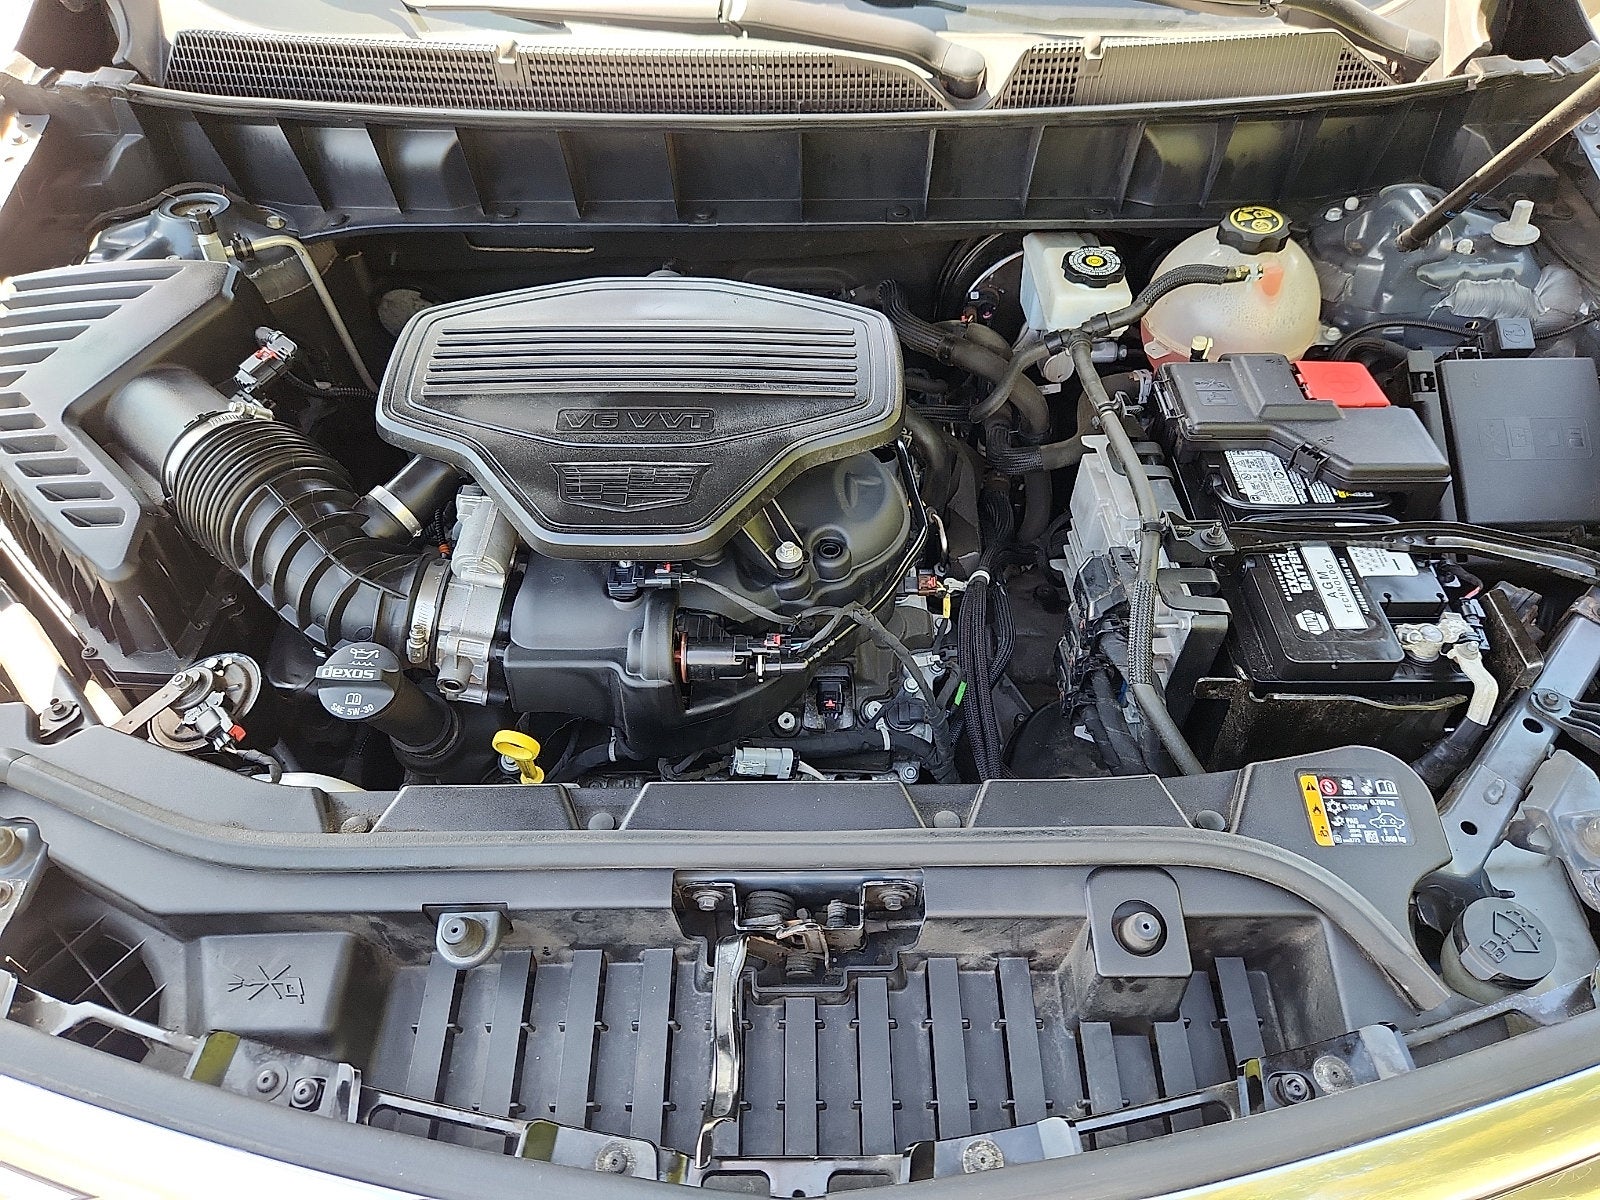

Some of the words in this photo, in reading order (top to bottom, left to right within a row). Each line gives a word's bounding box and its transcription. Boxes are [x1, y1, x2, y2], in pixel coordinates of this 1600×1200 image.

[564, 412, 619, 428] V6
[627, 412, 710, 428] VVT
[1268, 553, 1293, 602] MAINTENANCE
[1317, 571, 1339, 599] AGM
[1323, 558, 1353, 614] TECHNOLOGY
[321, 666, 375, 679] dexos
[330, 703, 346, 715] SAE
[346, 703, 375, 716] 5W-30
